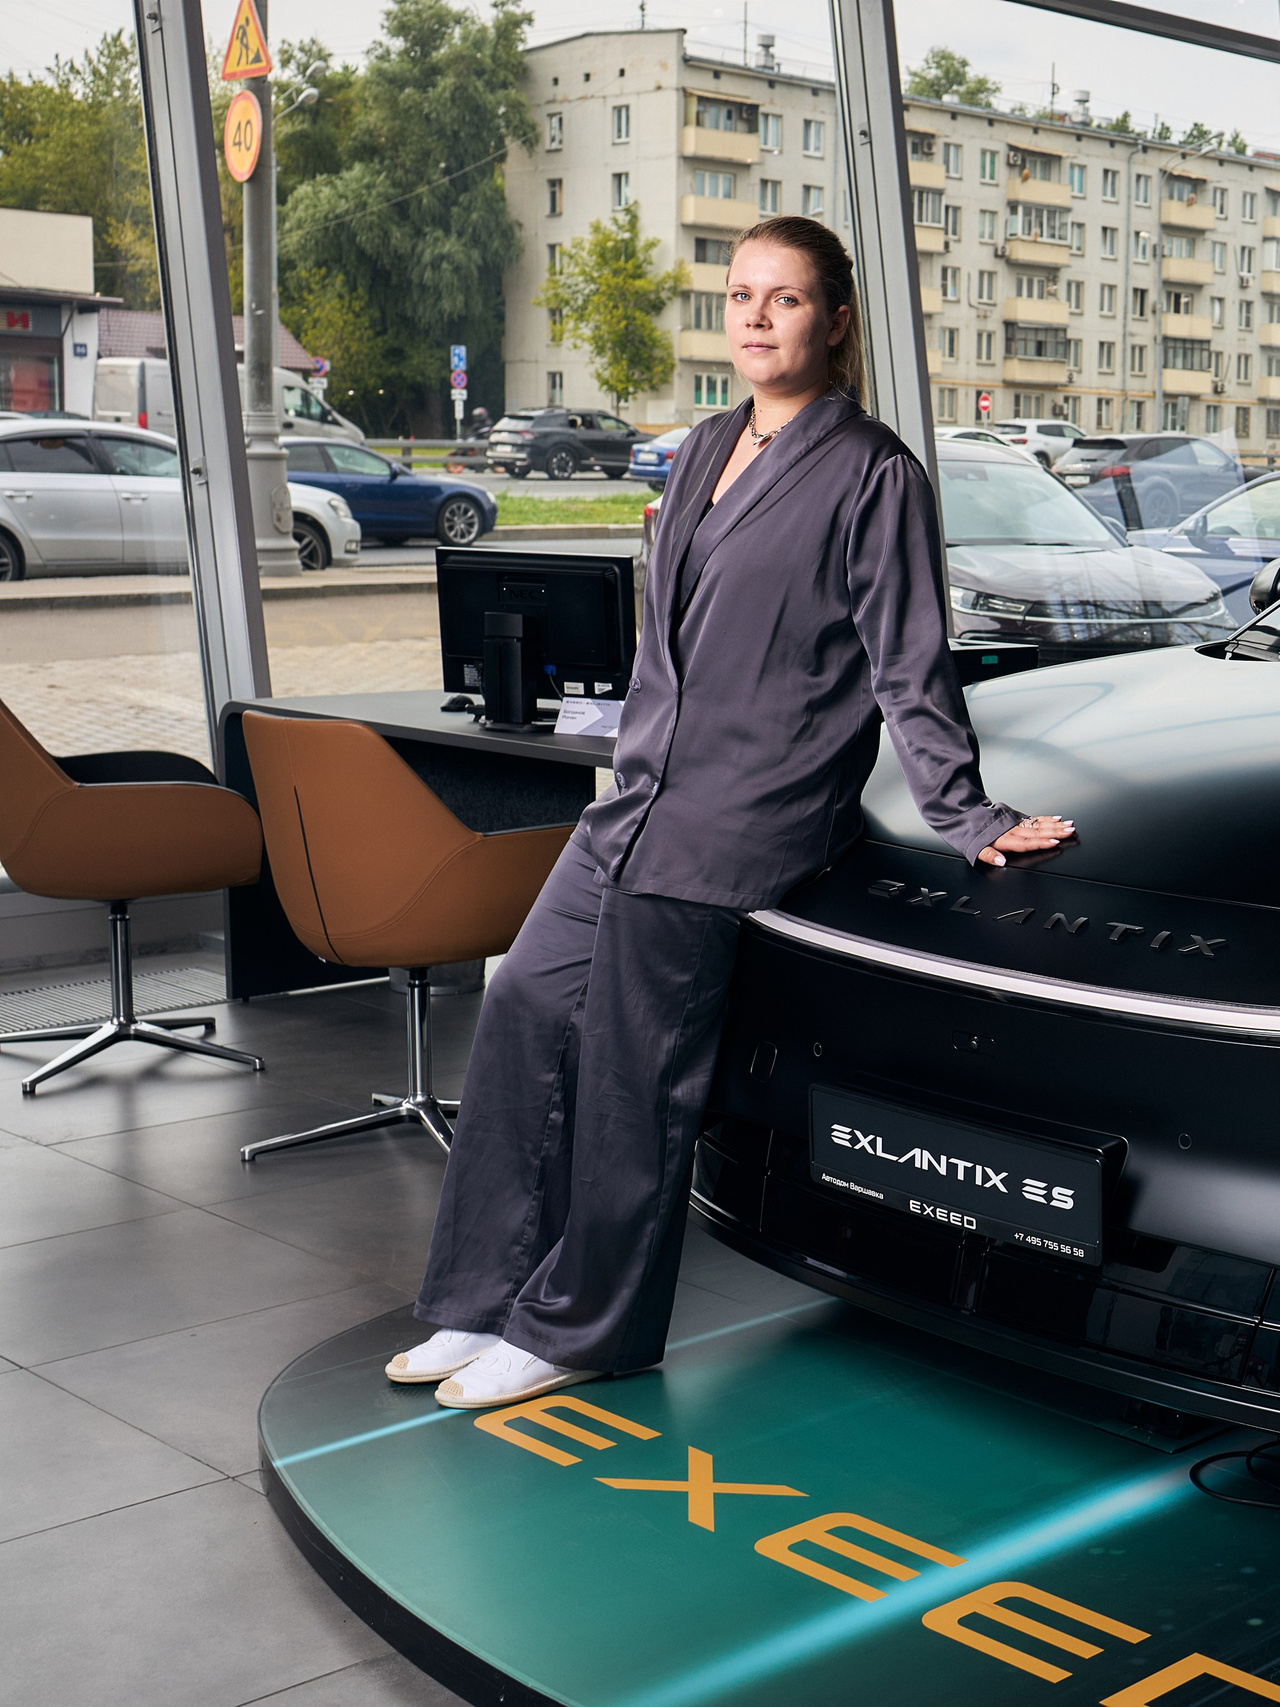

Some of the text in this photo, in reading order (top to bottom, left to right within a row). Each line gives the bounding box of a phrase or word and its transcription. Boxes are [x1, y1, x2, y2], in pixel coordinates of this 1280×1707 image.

[232, 119, 253, 152] 40
[509, 588, 539, 600] NEC
[867, 879, 1228, 957] EXLANTIX
[830, 1123, 1075, 1211] EXLANTIX ES
[821, 1172, 884, 1200] Автодом Варшавка
[909, 1199, 977, 1230] EXEED
[1014, 1232, 1085, 1258] +7 495 755 56 58
